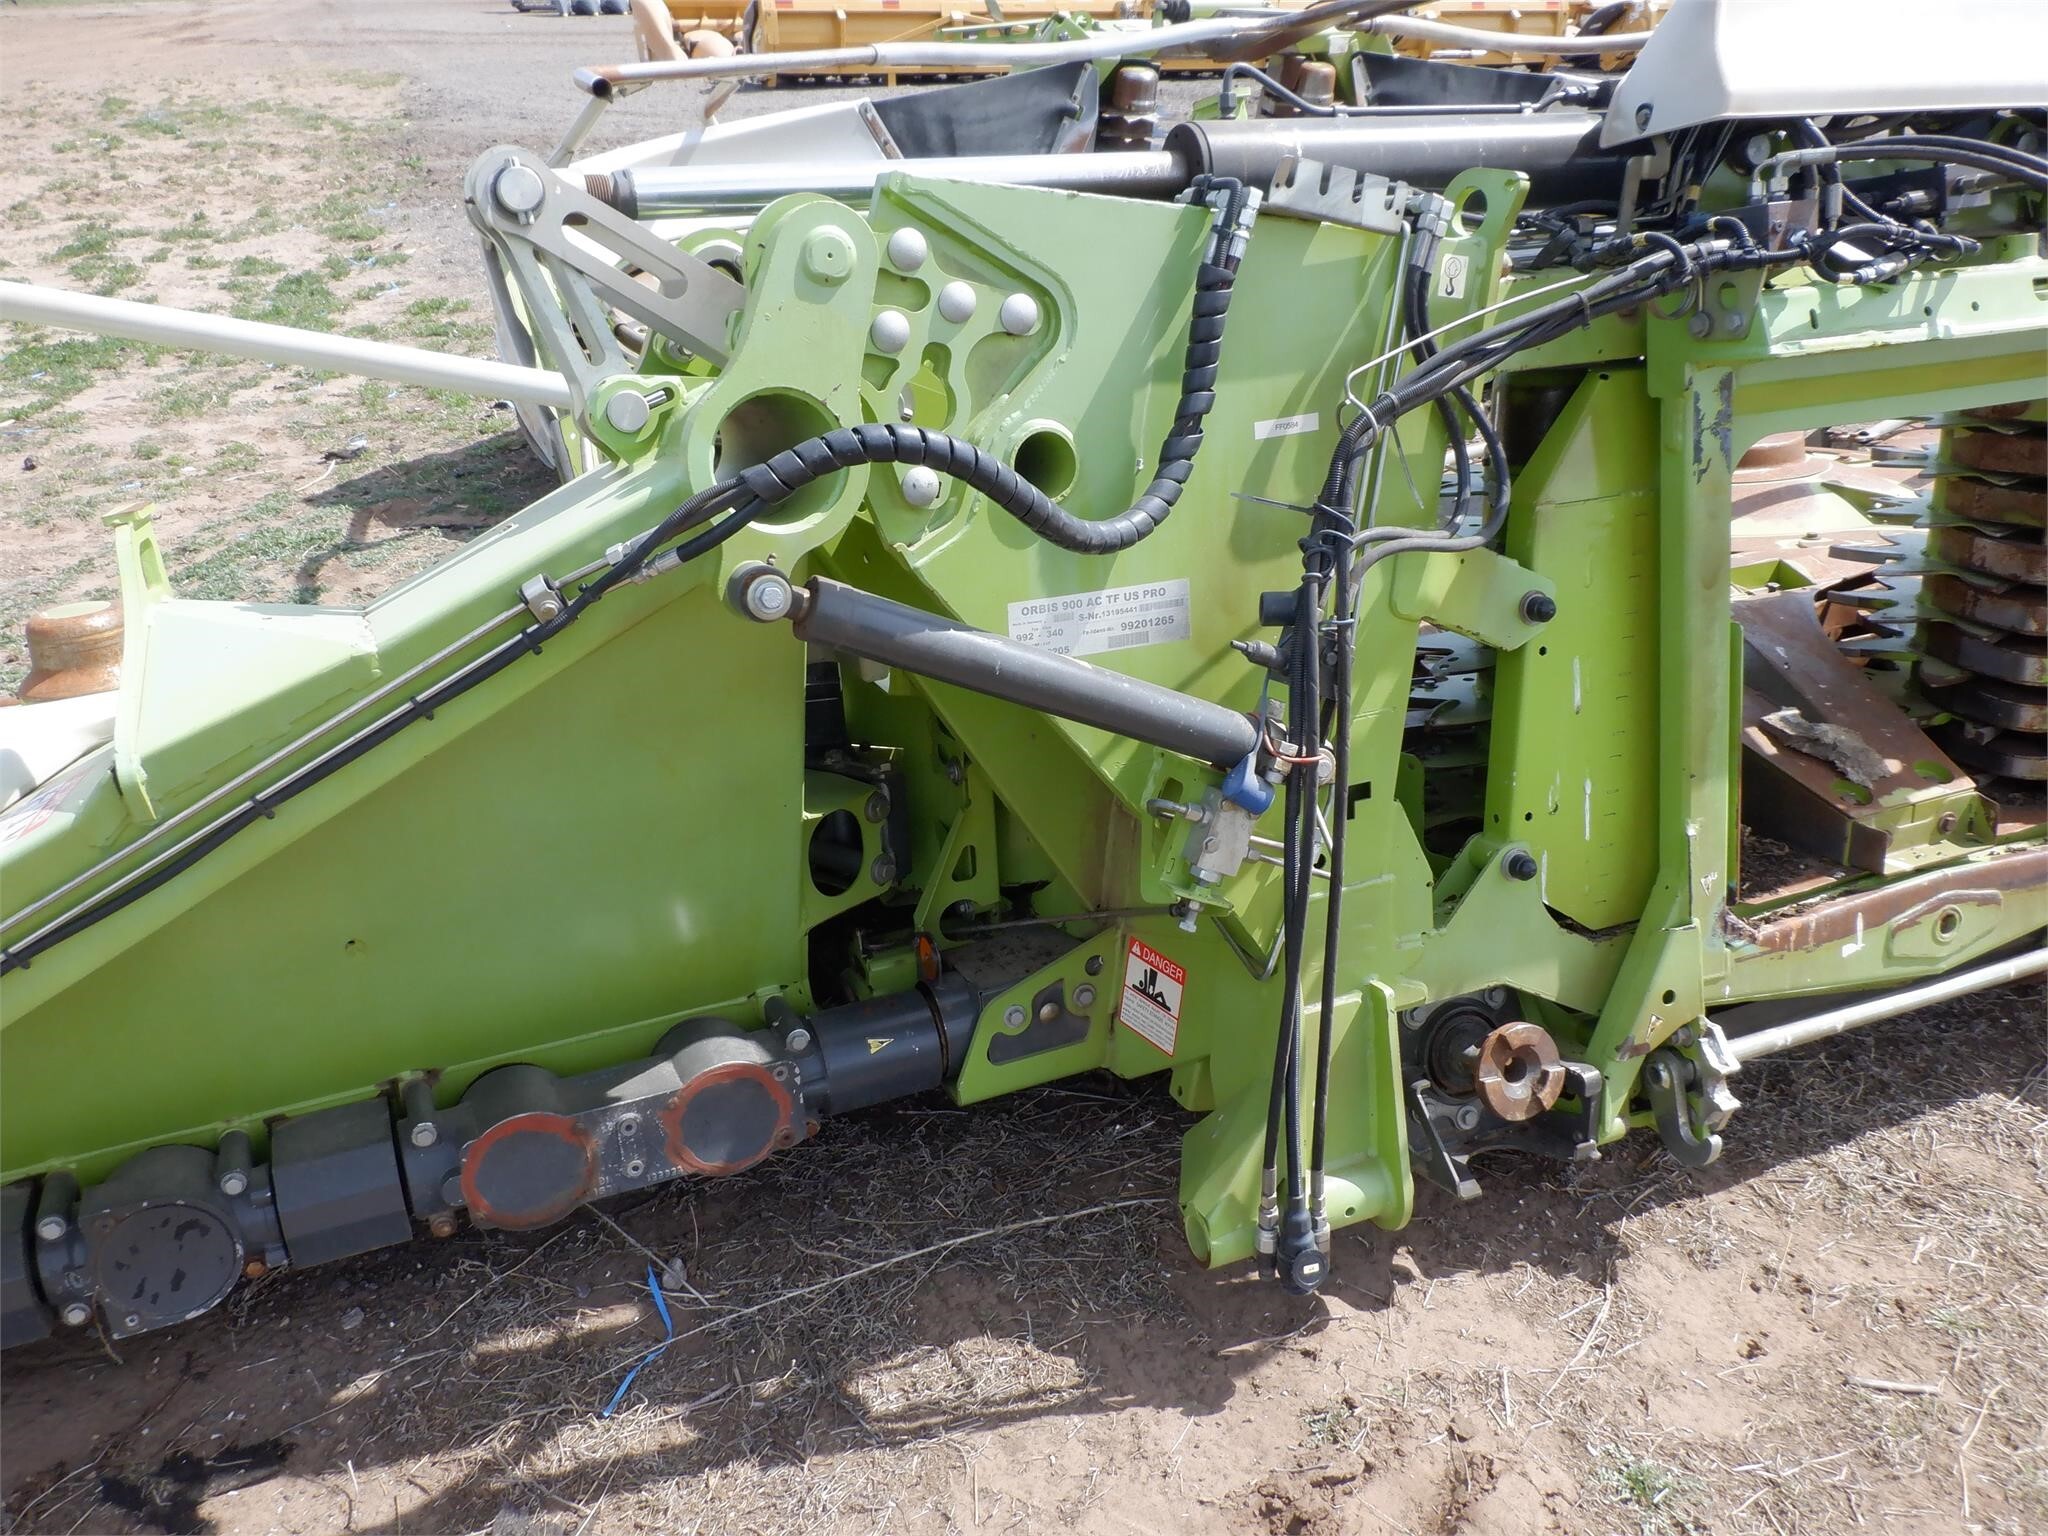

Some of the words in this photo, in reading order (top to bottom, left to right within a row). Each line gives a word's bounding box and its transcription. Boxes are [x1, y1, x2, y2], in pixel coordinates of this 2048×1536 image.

[1021, 601, 1059, 616] ORBIS
[1062, 599, 1083, 611] 900
[1086, 596, 1103, 607] AC
[1106, 593, 1120, 605] TF
[1124, 590, 1139, 602] US
[1143, 587, 1166, 600] PRO
[1016, 632, 1034, 642] 992
[1047, 628, 1063, 638] 340
[1120, 615, 1174, 632] 99201265
[1142, 948, 1183, 982] DANGER
